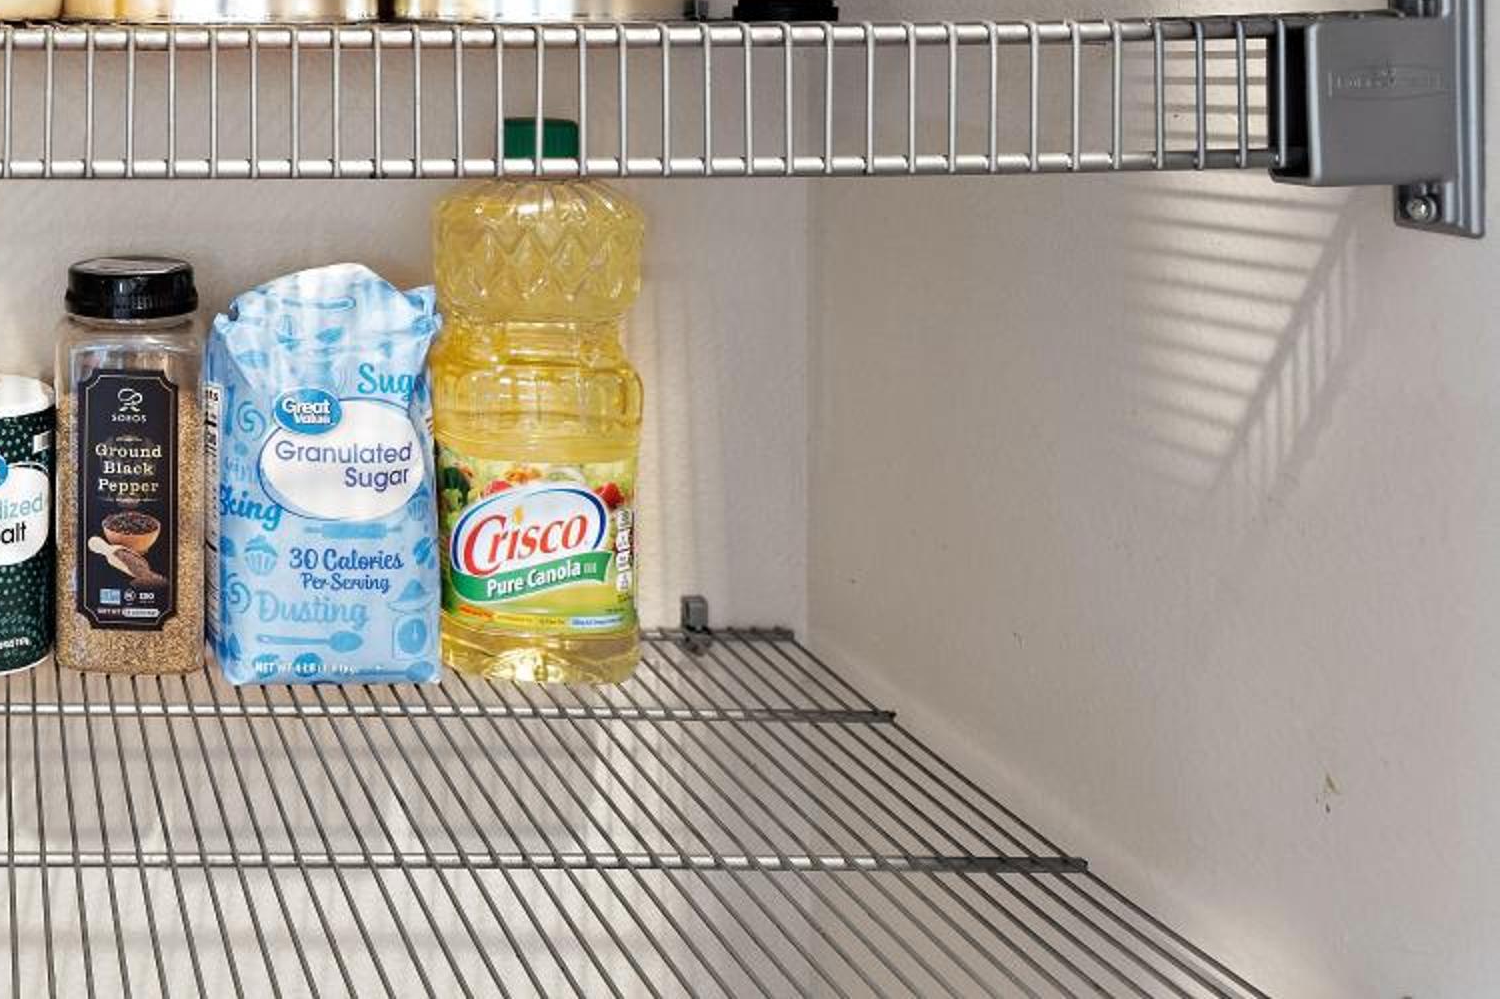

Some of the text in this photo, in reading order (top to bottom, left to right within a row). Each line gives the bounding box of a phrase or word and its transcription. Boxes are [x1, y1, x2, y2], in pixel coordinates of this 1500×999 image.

[282, 398, 331, 415] Great
[95, 443, 162, 458] Ground
[275, 440, 413, 464] Granulated
[103, 461, 155, 475] Black
[98, 478, 160, 496] Pepper
[345, 467, 410, 492] Sugar
[463, 509, 588, 578] Crisco
[289, 548, 405, 571] 30 Calories
[301, 572, 390, 594] Per Serving
[486, 574, 523, 598] Pure
[527, 561, 582, 586] Canola
[255, 589, 368, 630] Dusting
[255, 662, 274, 673] NET
